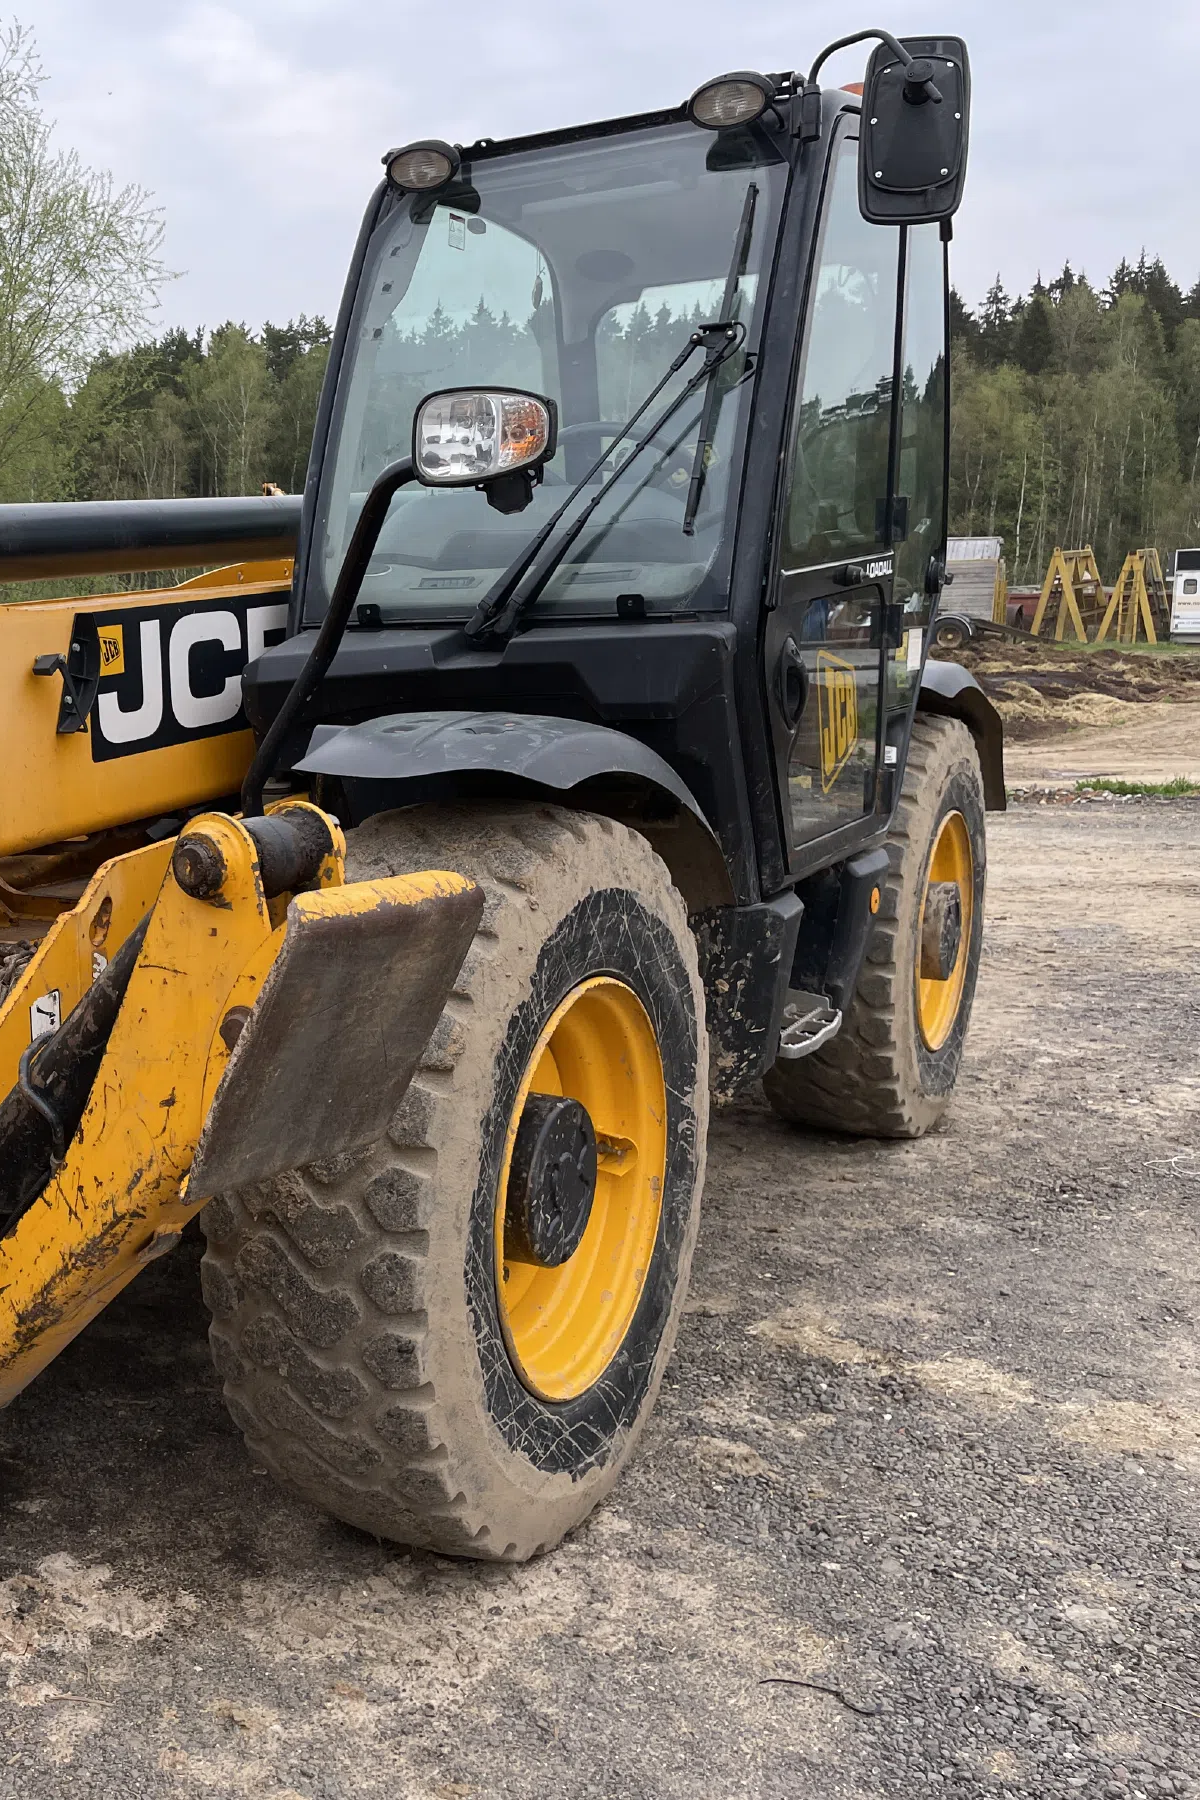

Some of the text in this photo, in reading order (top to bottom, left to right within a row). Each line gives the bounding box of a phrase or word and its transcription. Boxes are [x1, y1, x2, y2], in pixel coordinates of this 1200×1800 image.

[866, 560, 893, 578] LOADALL
[103, 640, 119, 662] JCB
[823, 666, 854, 776] JCB
